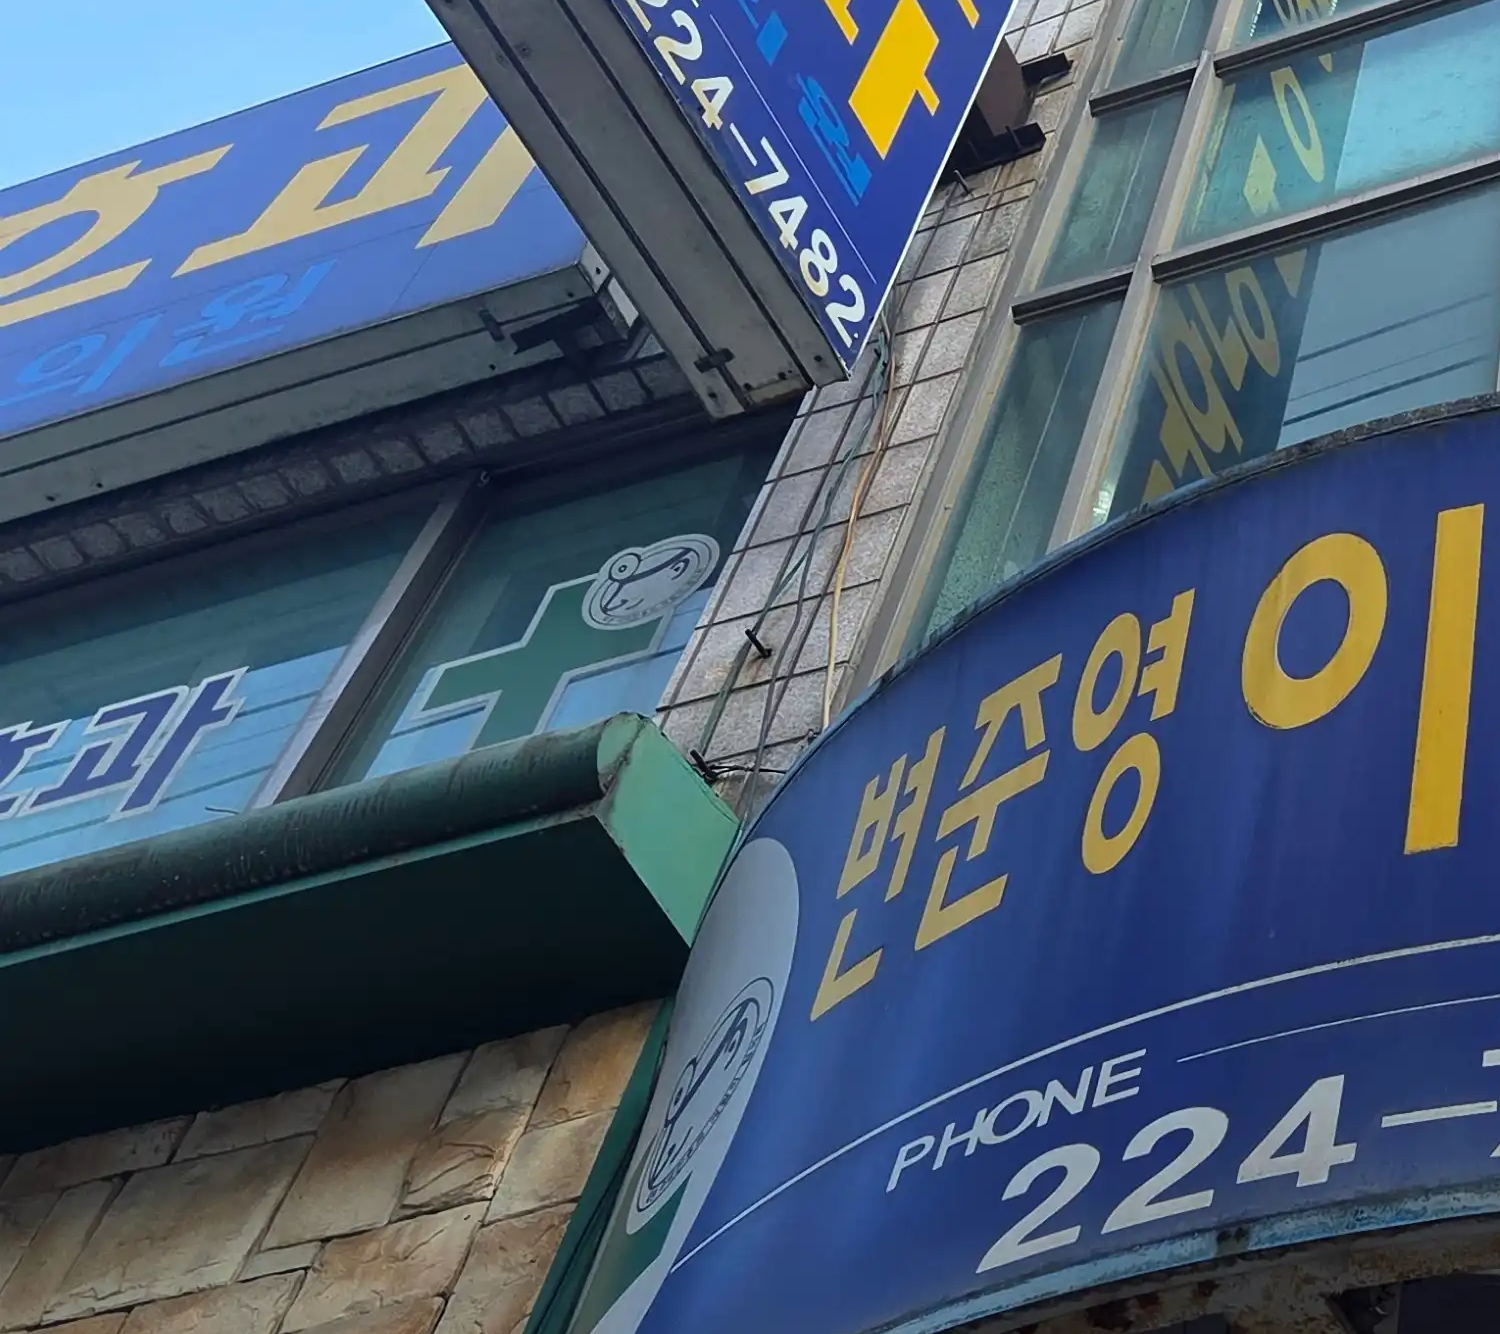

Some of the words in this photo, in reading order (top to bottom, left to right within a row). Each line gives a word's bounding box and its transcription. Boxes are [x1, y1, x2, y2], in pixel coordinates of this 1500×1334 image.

[0, 259, 337, 407] 의원
[810, 587, 1196, 1022] 변준영
[885, 1049, 1148, 1195] PHONE
